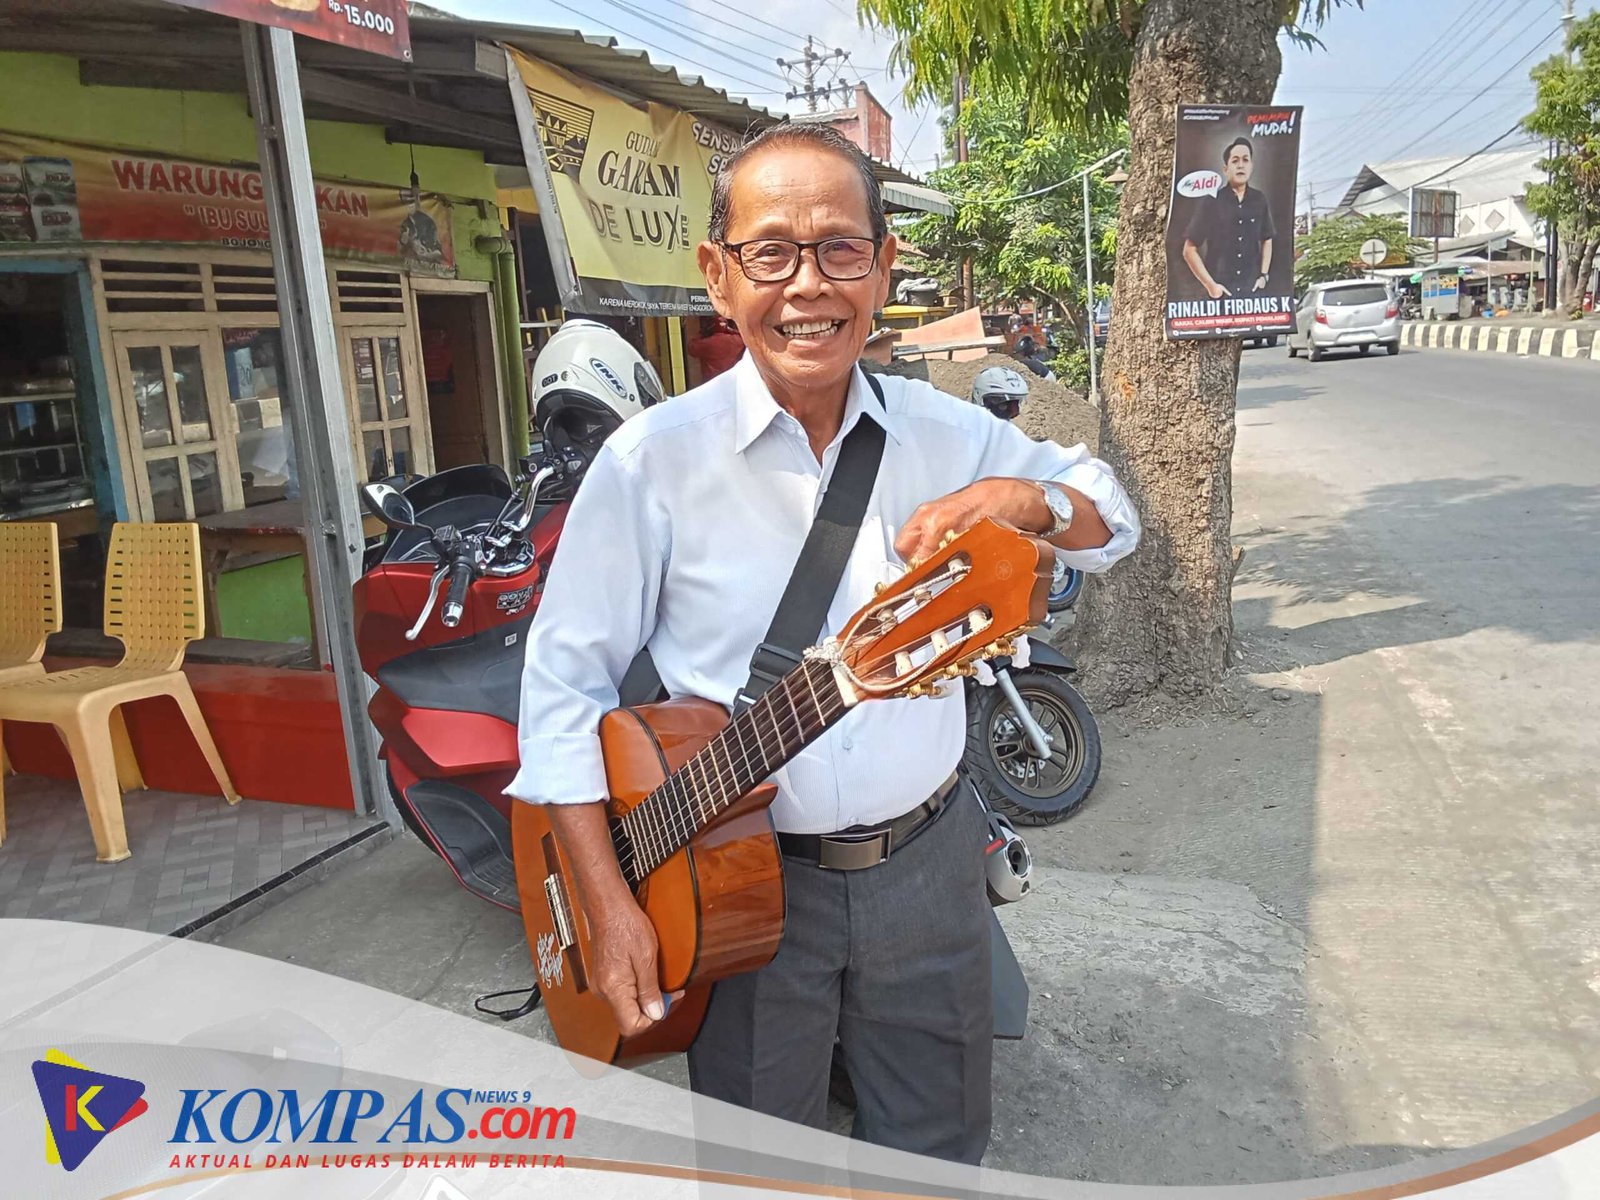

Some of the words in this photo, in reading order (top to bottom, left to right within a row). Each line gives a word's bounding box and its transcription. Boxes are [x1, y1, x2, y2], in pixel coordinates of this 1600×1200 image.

[344, 4, 395, 35] 15.000
[1251, 111, 1296, 138] MUDA!
[111, 159, 264, 201] WARUNG
[314, 183, 369, 218] KAN
[1191, 175, 1218, 191] Aldi
[235, 209, 269, 233] SUL
[588, 199, 622, 243] DE
[625, 204, 691, 253] LUXE
[1168, 301, 1221, 318] RINALDI
[1224, 297, 1278, 315] FIRDAUS
[1281, 296, 1291, 312] K
[542, 374, 558, 387] DOT
[594, 362, 625, 392] INK
